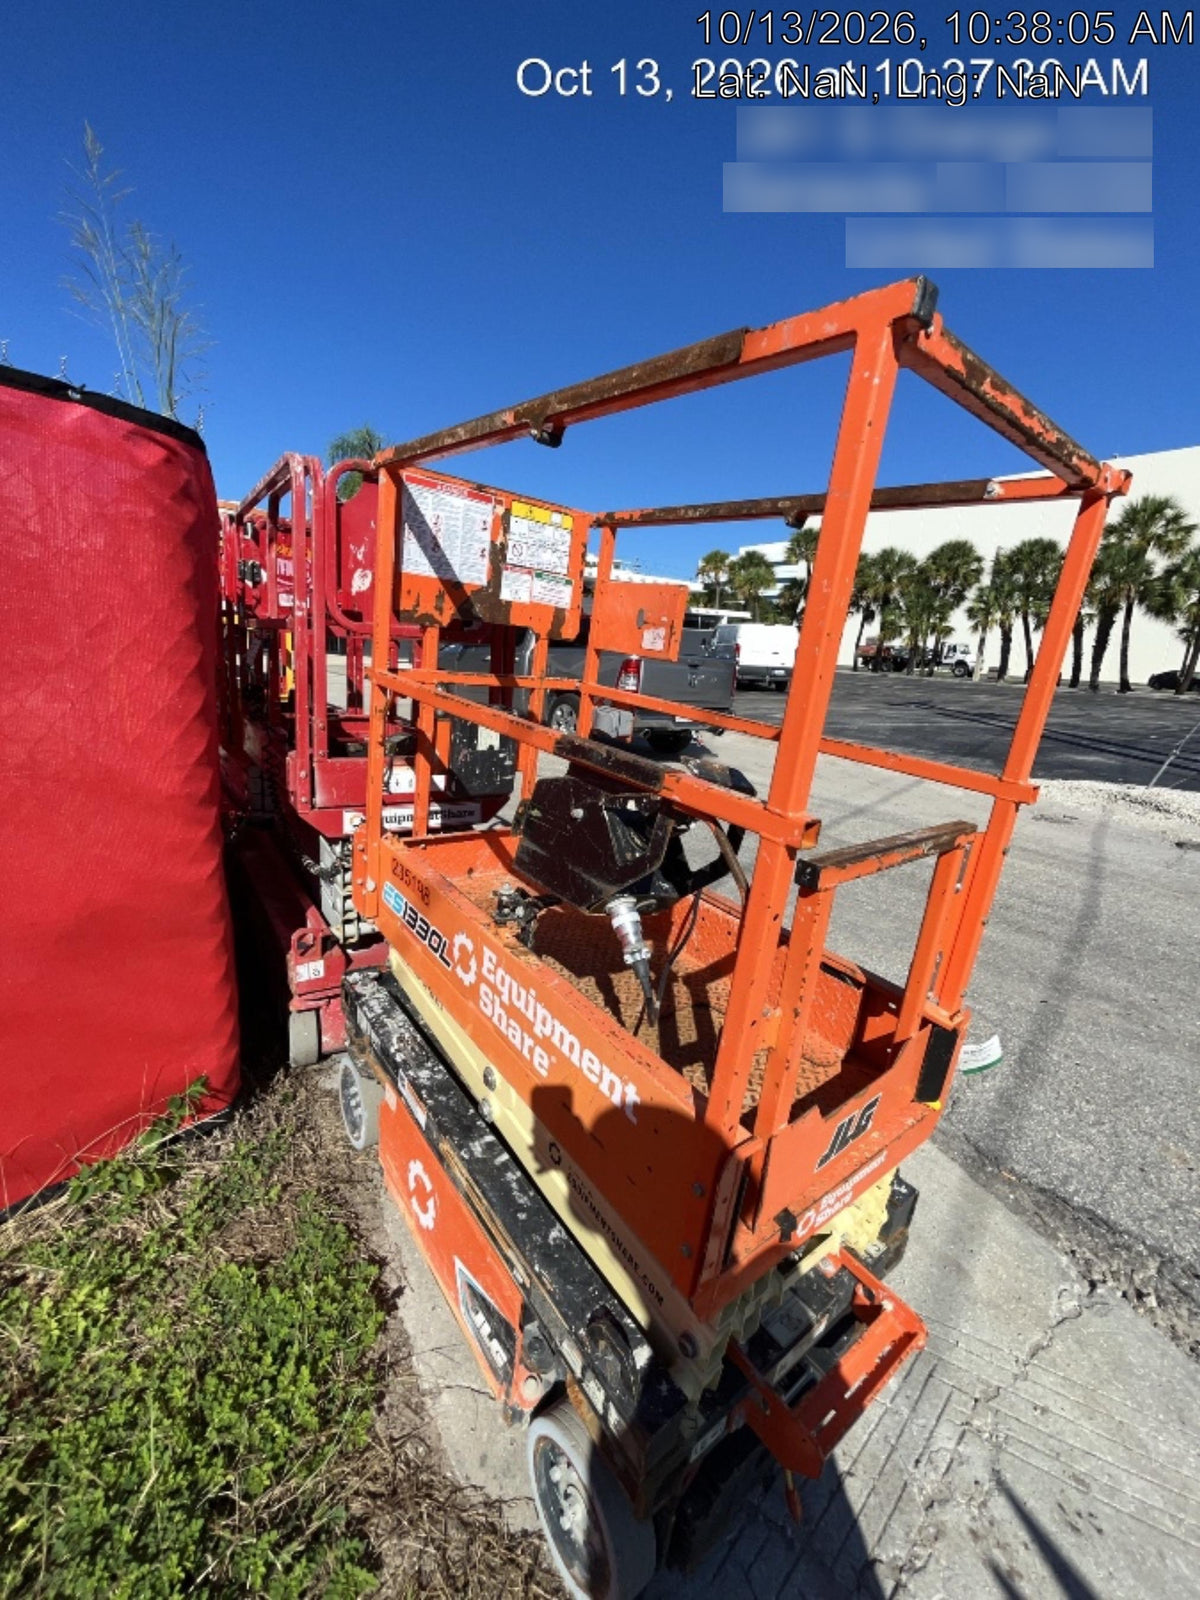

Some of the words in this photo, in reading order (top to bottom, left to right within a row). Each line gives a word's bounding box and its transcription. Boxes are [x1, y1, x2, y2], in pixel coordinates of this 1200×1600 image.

[383, 882, 452, 969] ES1330L
[478, 982, 551, 1079] Share
[481, 945, 642, 1127] Equipment
[814, 1092, 883, 1173] JLG
